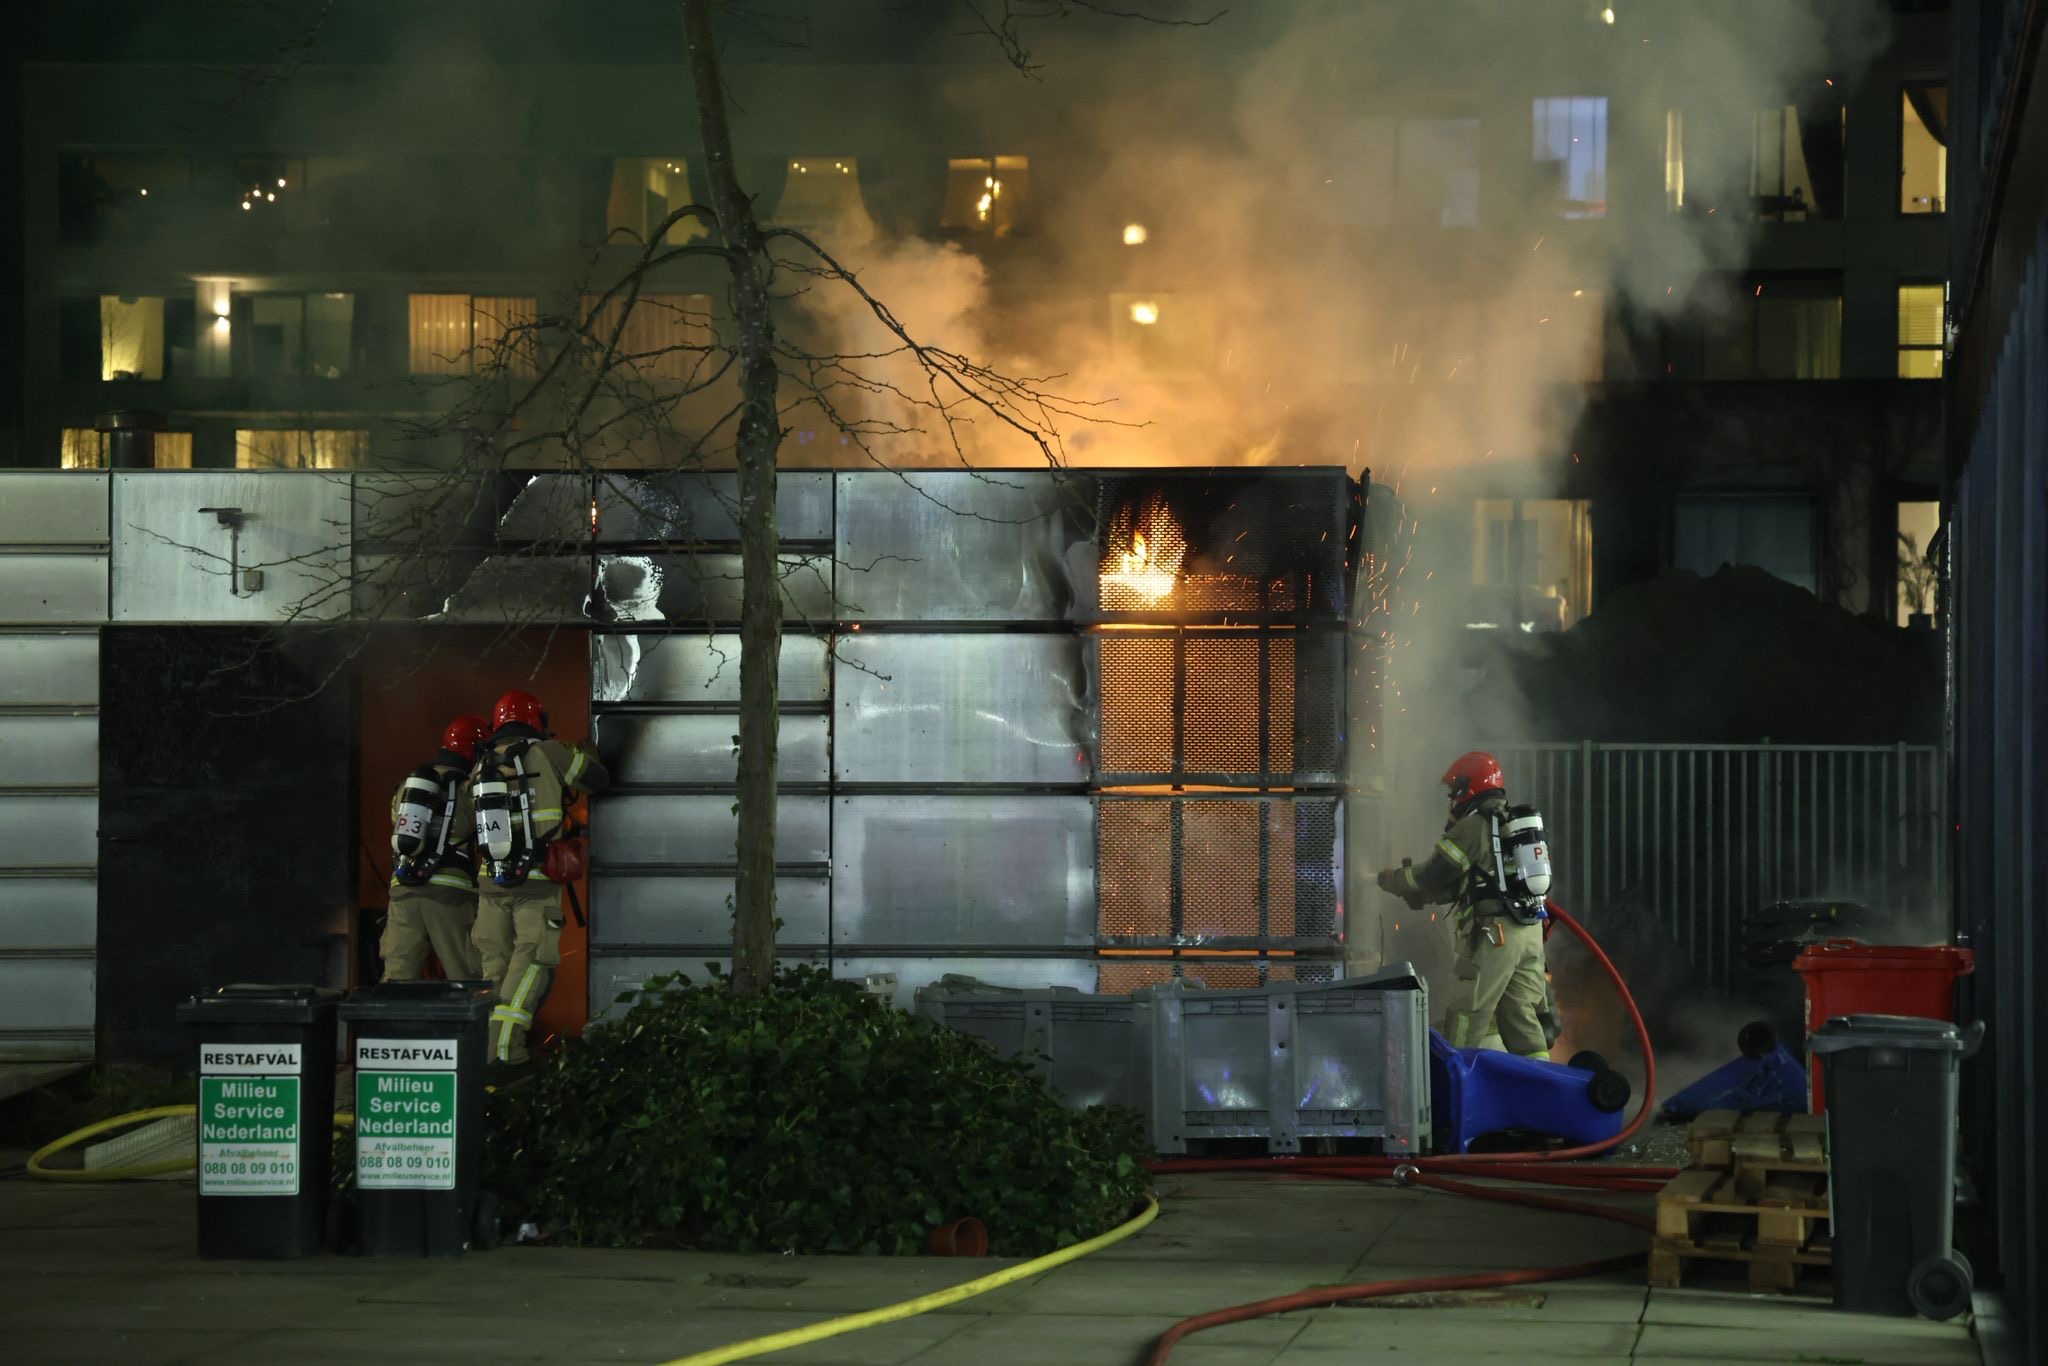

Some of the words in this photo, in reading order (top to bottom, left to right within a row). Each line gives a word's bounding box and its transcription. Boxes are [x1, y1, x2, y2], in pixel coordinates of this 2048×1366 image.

[204, 1052, 298, 1066] RESTAFVAL
[359, 1047, 454, 1061] RESTAFVAL
[221, 1082, 278, 1099] Milieu
[377, 1076, 434, 1093] Milieu
[213, 1103, 285, 1119] Service
[370, 1097, 441, 1114] Service
[203, 1123, 297, 1140] Nederland
[359, 1117, 453, 1134] Nederland
[374, 1142, 435, 1152] Afvalbeheer
[204, 1162, 227, 1175] 088
[230, 1162, 247, 1175] 08
[250, 1162, 267, 1175] 09
[270, 1161, 294, 1174] 010
[359, 1156, 383, 1169] 088
[386, 1156, 403, 1169] 08
[406, 1156, 423, 1169] 09
[426, 1156, 450, 1169] 010
